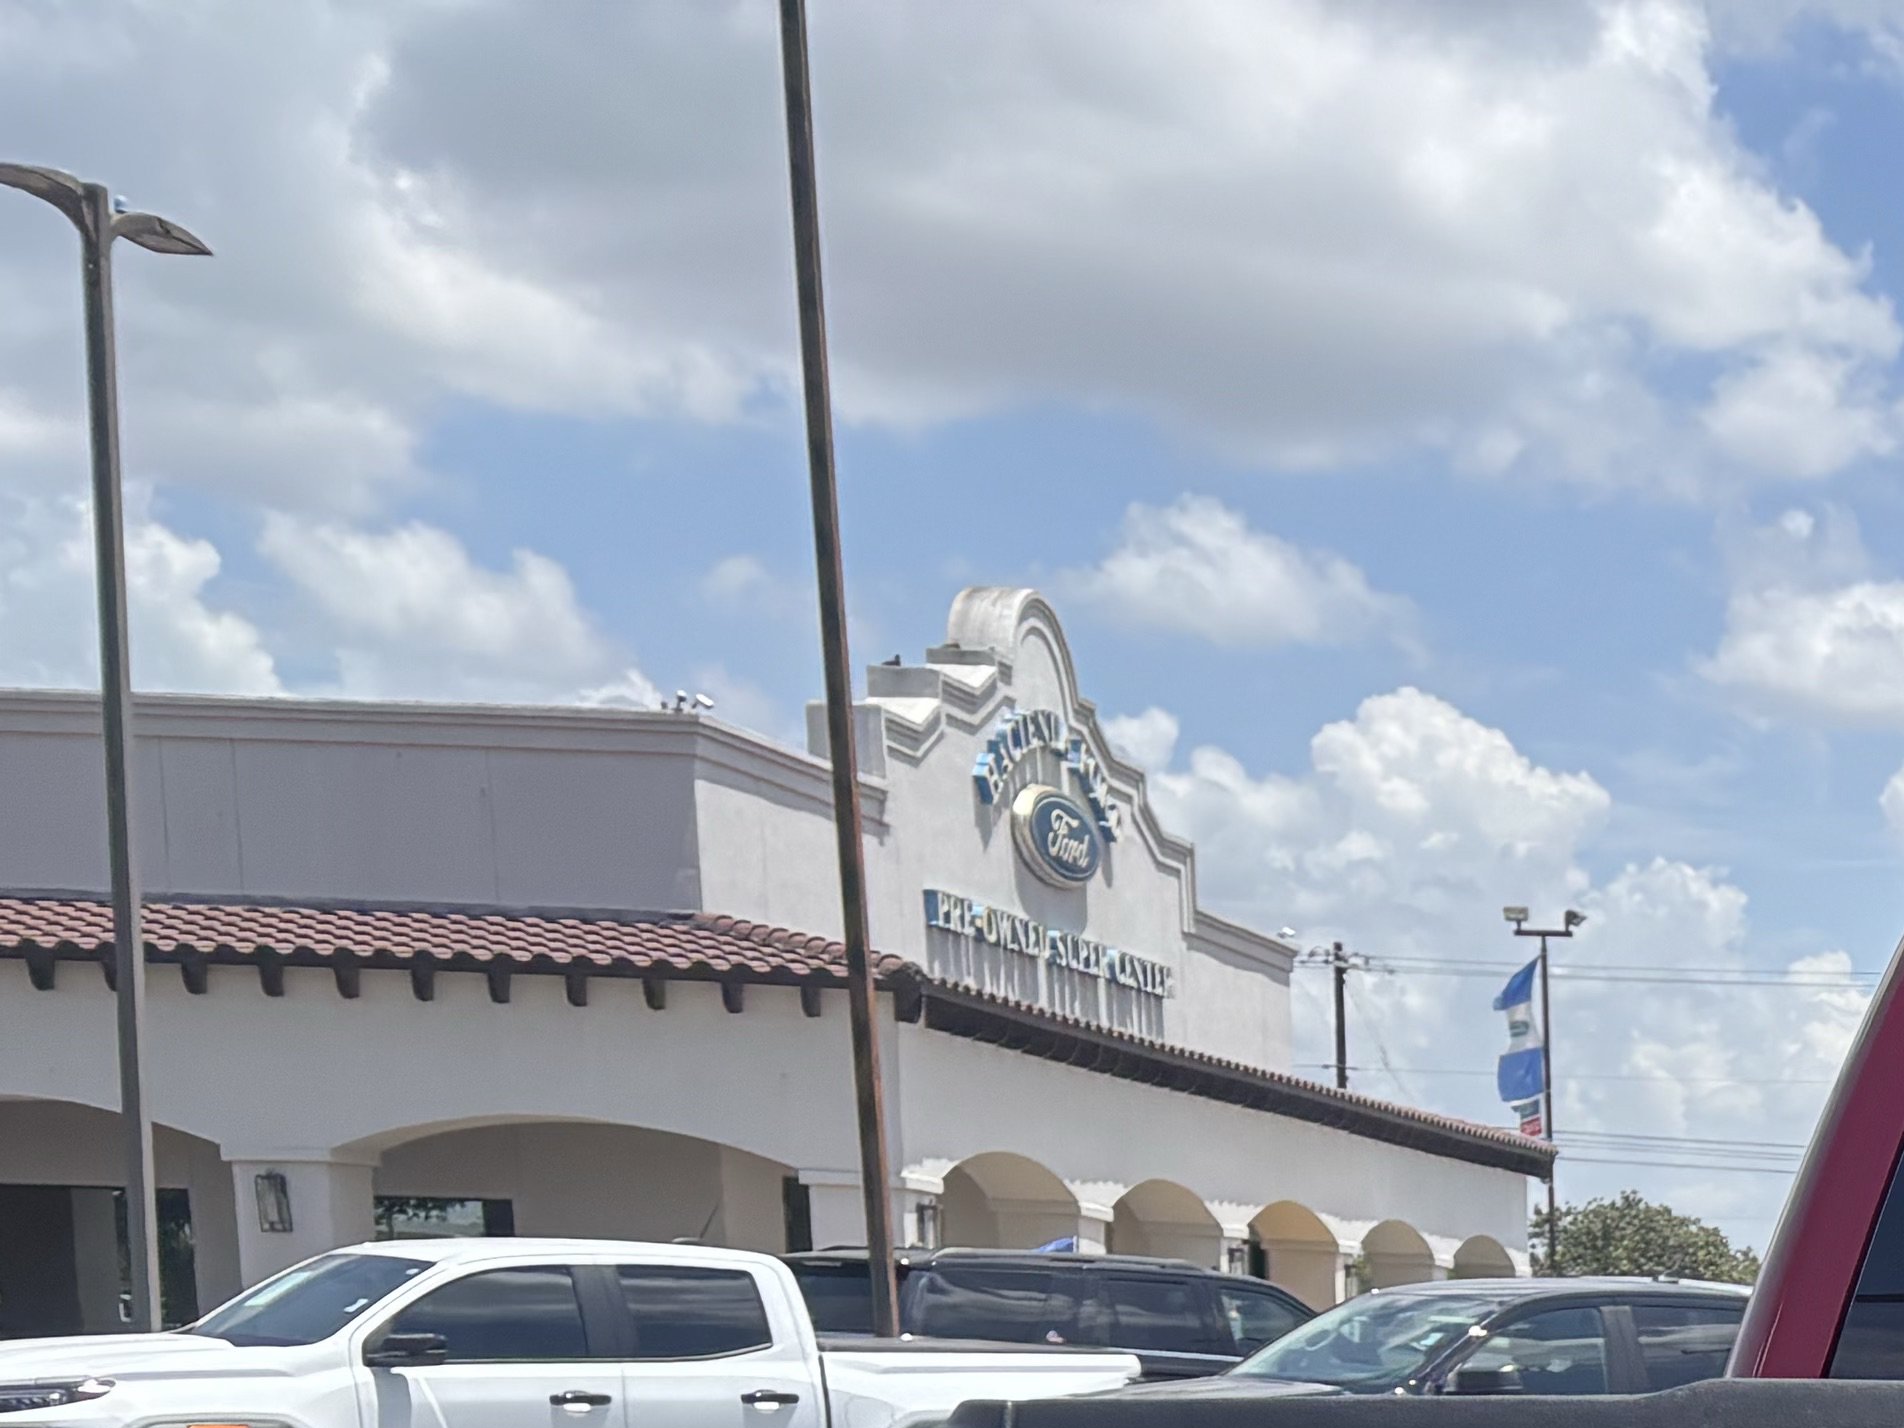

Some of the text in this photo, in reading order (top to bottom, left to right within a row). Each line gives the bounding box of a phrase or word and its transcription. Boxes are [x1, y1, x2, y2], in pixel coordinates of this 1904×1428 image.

[1047, 808, 1092, 868] Ford
[931, 890, 1050, 960] PRE-OWNED
[1054, 930, 1109, 979] SUPER
